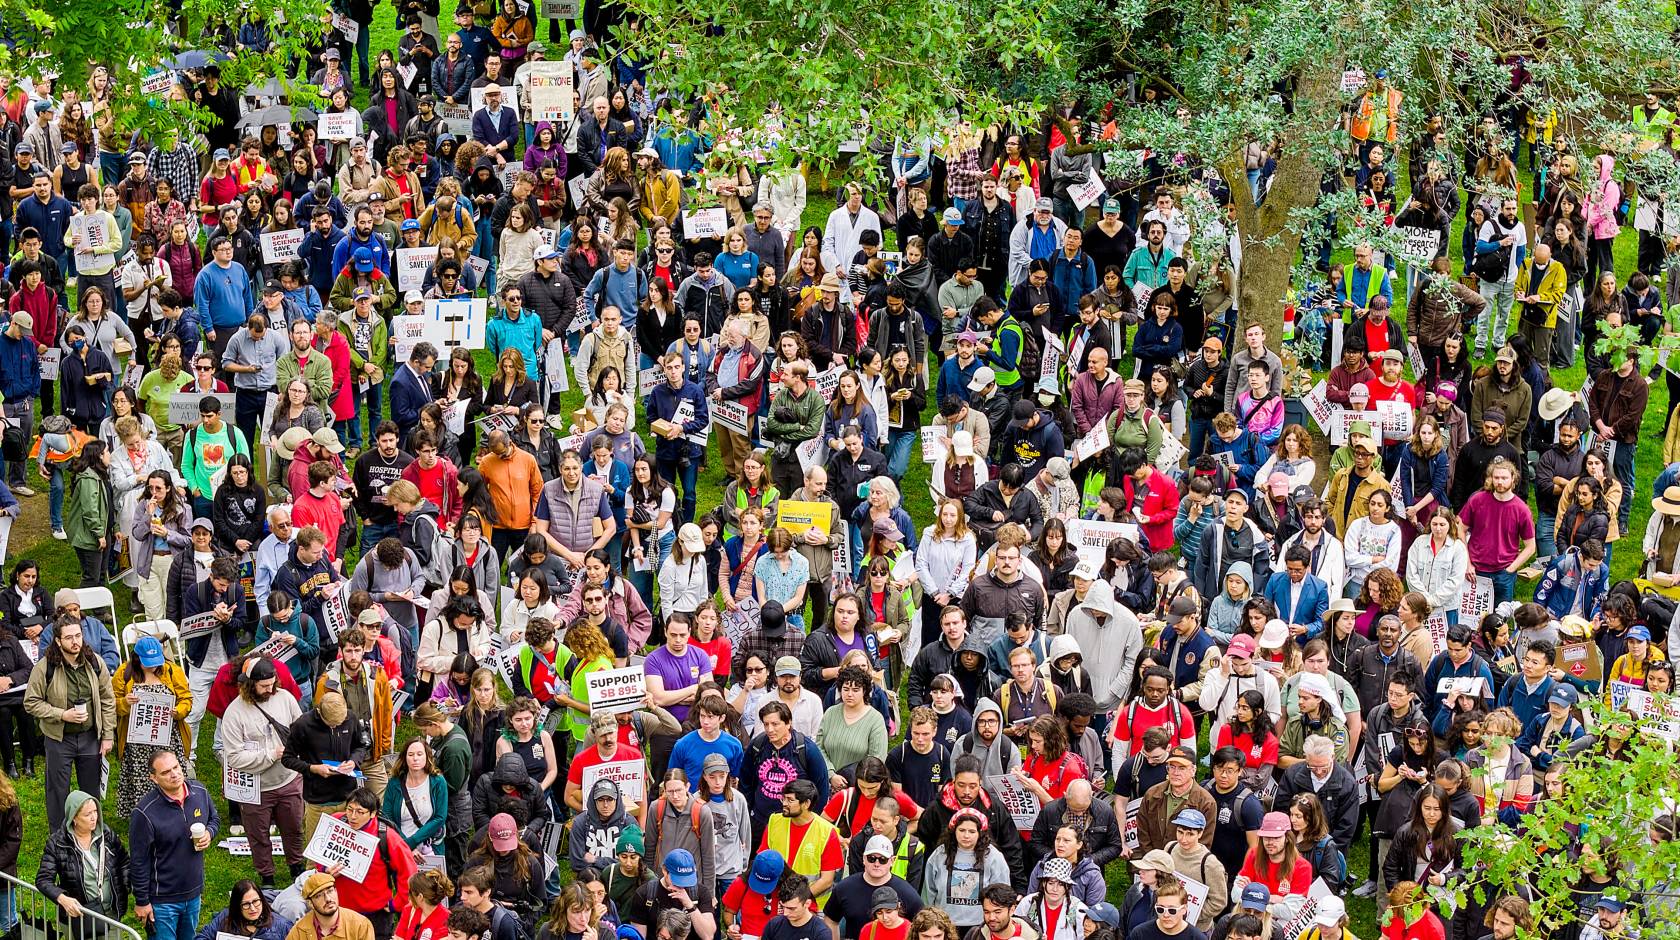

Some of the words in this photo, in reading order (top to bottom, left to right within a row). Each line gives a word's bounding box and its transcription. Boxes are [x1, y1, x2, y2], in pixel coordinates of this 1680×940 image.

[274, 250, 296, 258] LIVES.
[409, 261, 424, 269] SAVE
[406, 329, 422, 338] SAVE
[727, 411, 741, 422] 895
[1083, 528, 1097, 537] SAVE
[1082, 536, 1100, 547] SAVE
[1461, 592, 1470, 616] SAVE
[1475, 594, 1483, 616] SAVE
[1436, 617, 1446, 639] SAVE
[590, 673, 642, 689] SUPPORT
[600, 688, 616, 699] SB
[618, 685, 638, 696] 895
[135, 703, 146, 729] LIVES.
[144, 704, 154, 725] SAVE
[160, 706, 170, 727] SAVE
[150, 705, 162, 742] SCIENCE.
[598, 767, 622, 777] SAVE
[761, 787, 784, 799] REGIO
[1004, 790, 1014, 814] SAVE
[1020, 791, 1028, 814] SAVE
[333, 824, 357, 841] SAVE
[326, 841, 351, 857] SAVE
[330, 833, 370, 858] SCIENCE.
[322, 849, 351, 869] LIVES.
[950, 898, 979, 906] IDAHO
